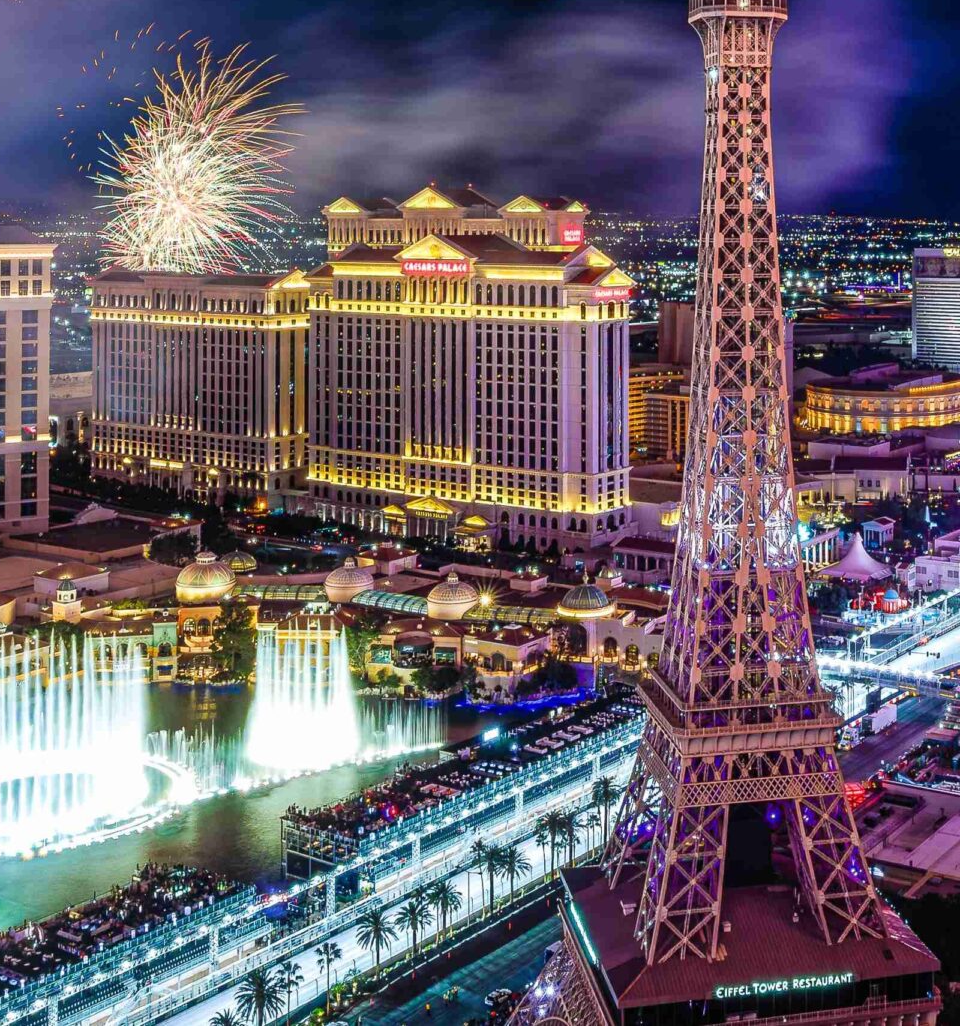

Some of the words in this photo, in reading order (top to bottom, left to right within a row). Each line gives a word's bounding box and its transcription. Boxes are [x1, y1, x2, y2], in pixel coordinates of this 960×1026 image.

[404, 262, 436, 271] CAESARS
[437, 262, 467, 272] PALACE
[716, 985, 751, 999] EIFFEL
[752, 980, 789, 994] TOWER
[792, 973, 853, 989] RESTAURANT
